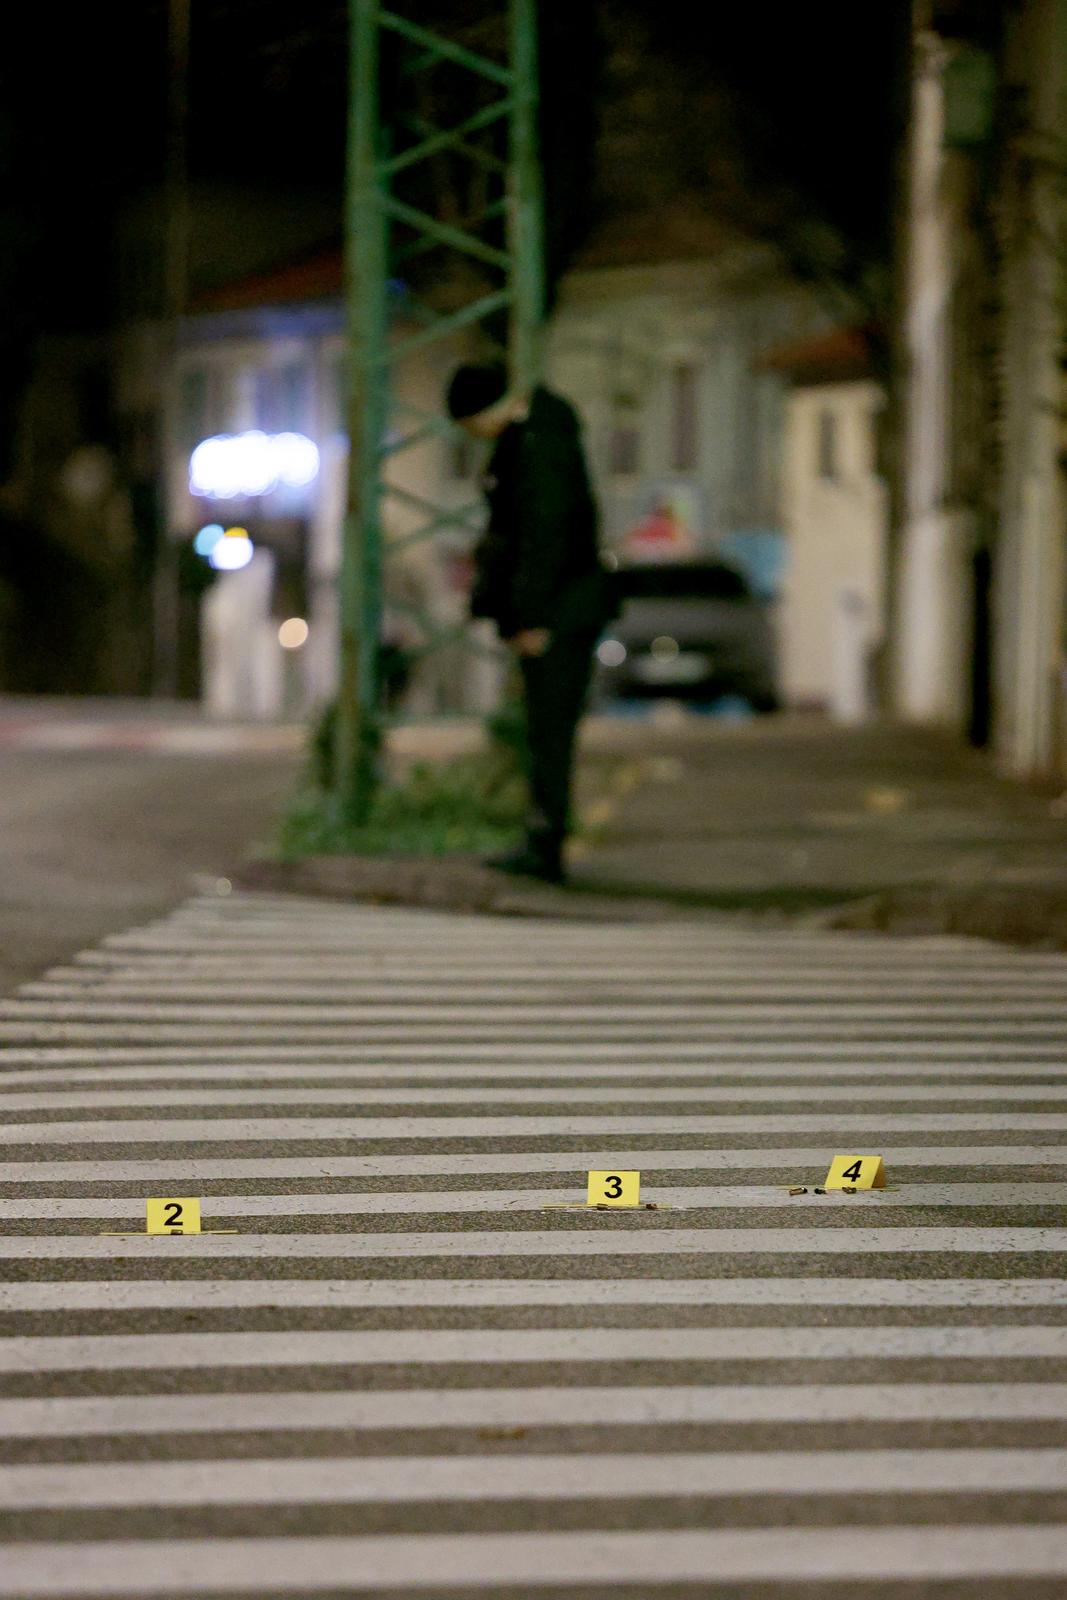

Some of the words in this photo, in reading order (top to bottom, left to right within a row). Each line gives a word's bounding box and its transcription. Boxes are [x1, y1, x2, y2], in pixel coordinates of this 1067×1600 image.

[842, 1160, 863, 1183] 4
[604, 1175, 623, 1199] 3
[164, 1203, 184, 1226] 2
